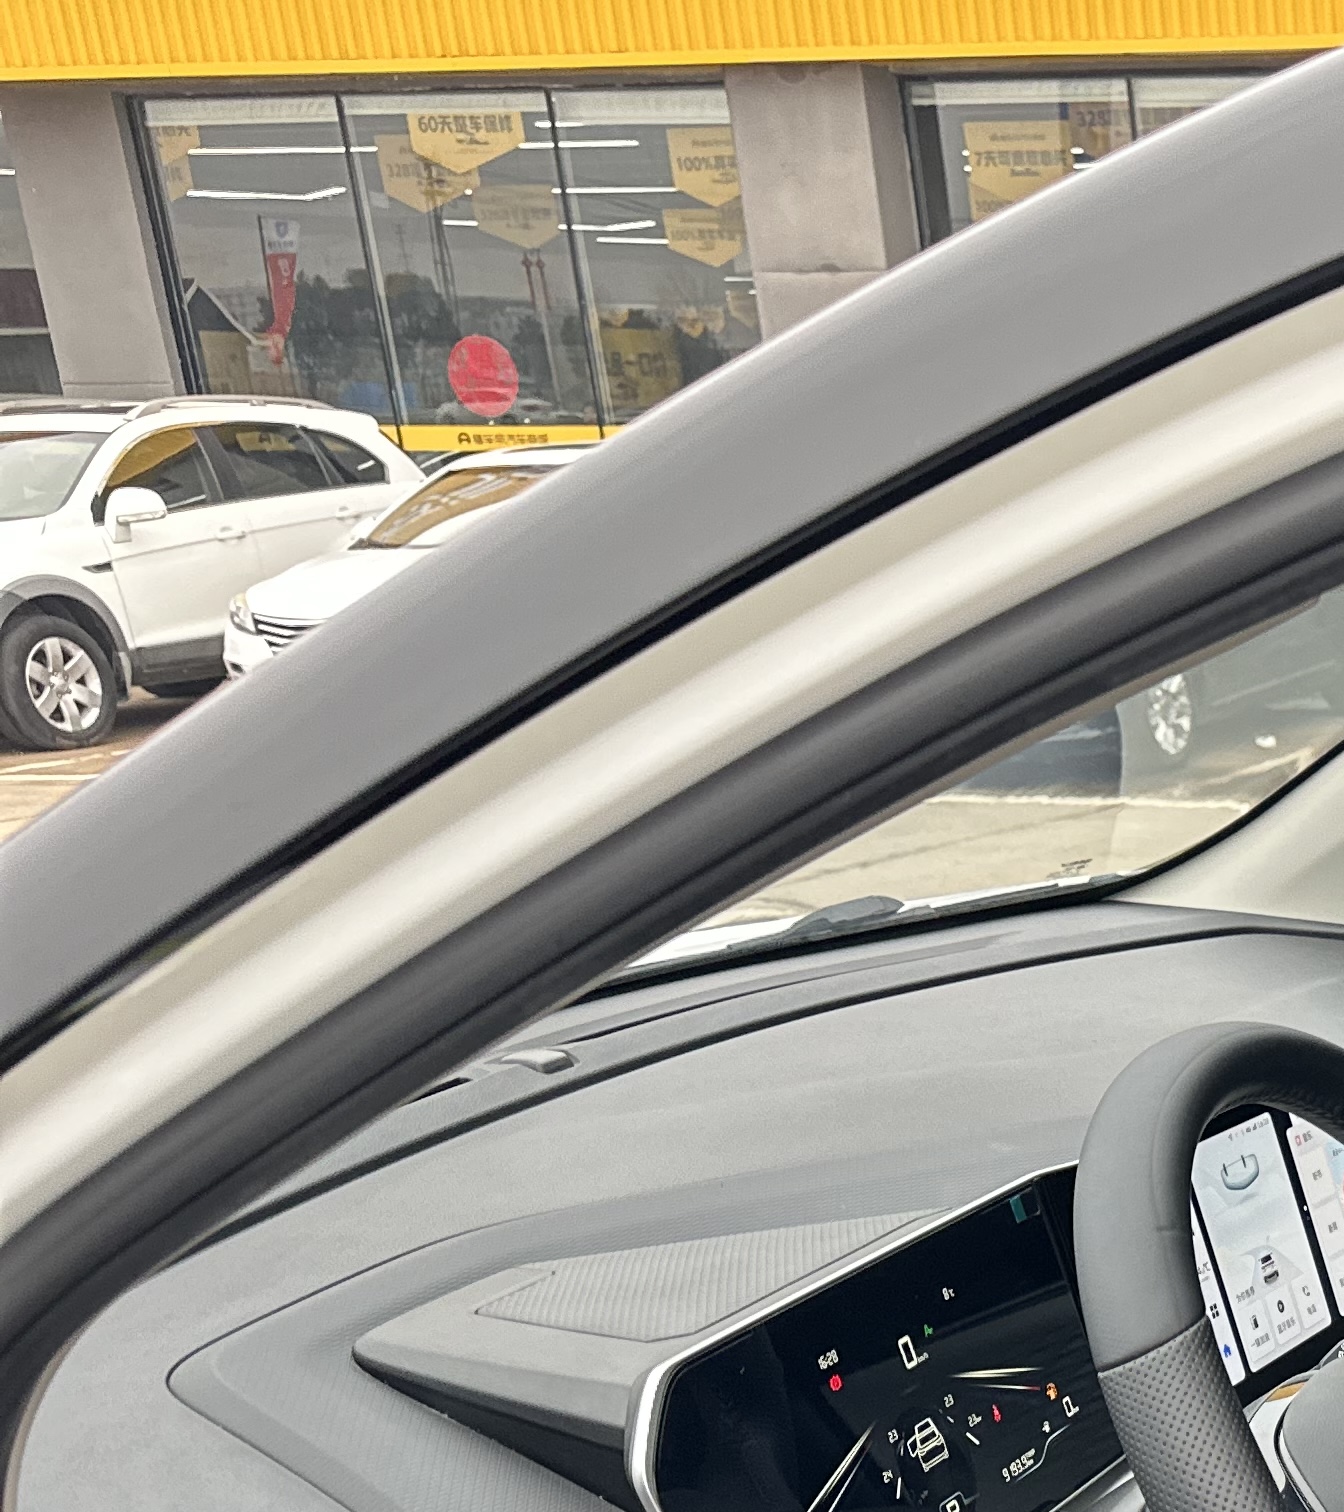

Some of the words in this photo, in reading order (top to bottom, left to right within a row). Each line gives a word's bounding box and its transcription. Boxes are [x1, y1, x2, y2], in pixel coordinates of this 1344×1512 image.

[417, 114, 514, 134] 60天整车保修
